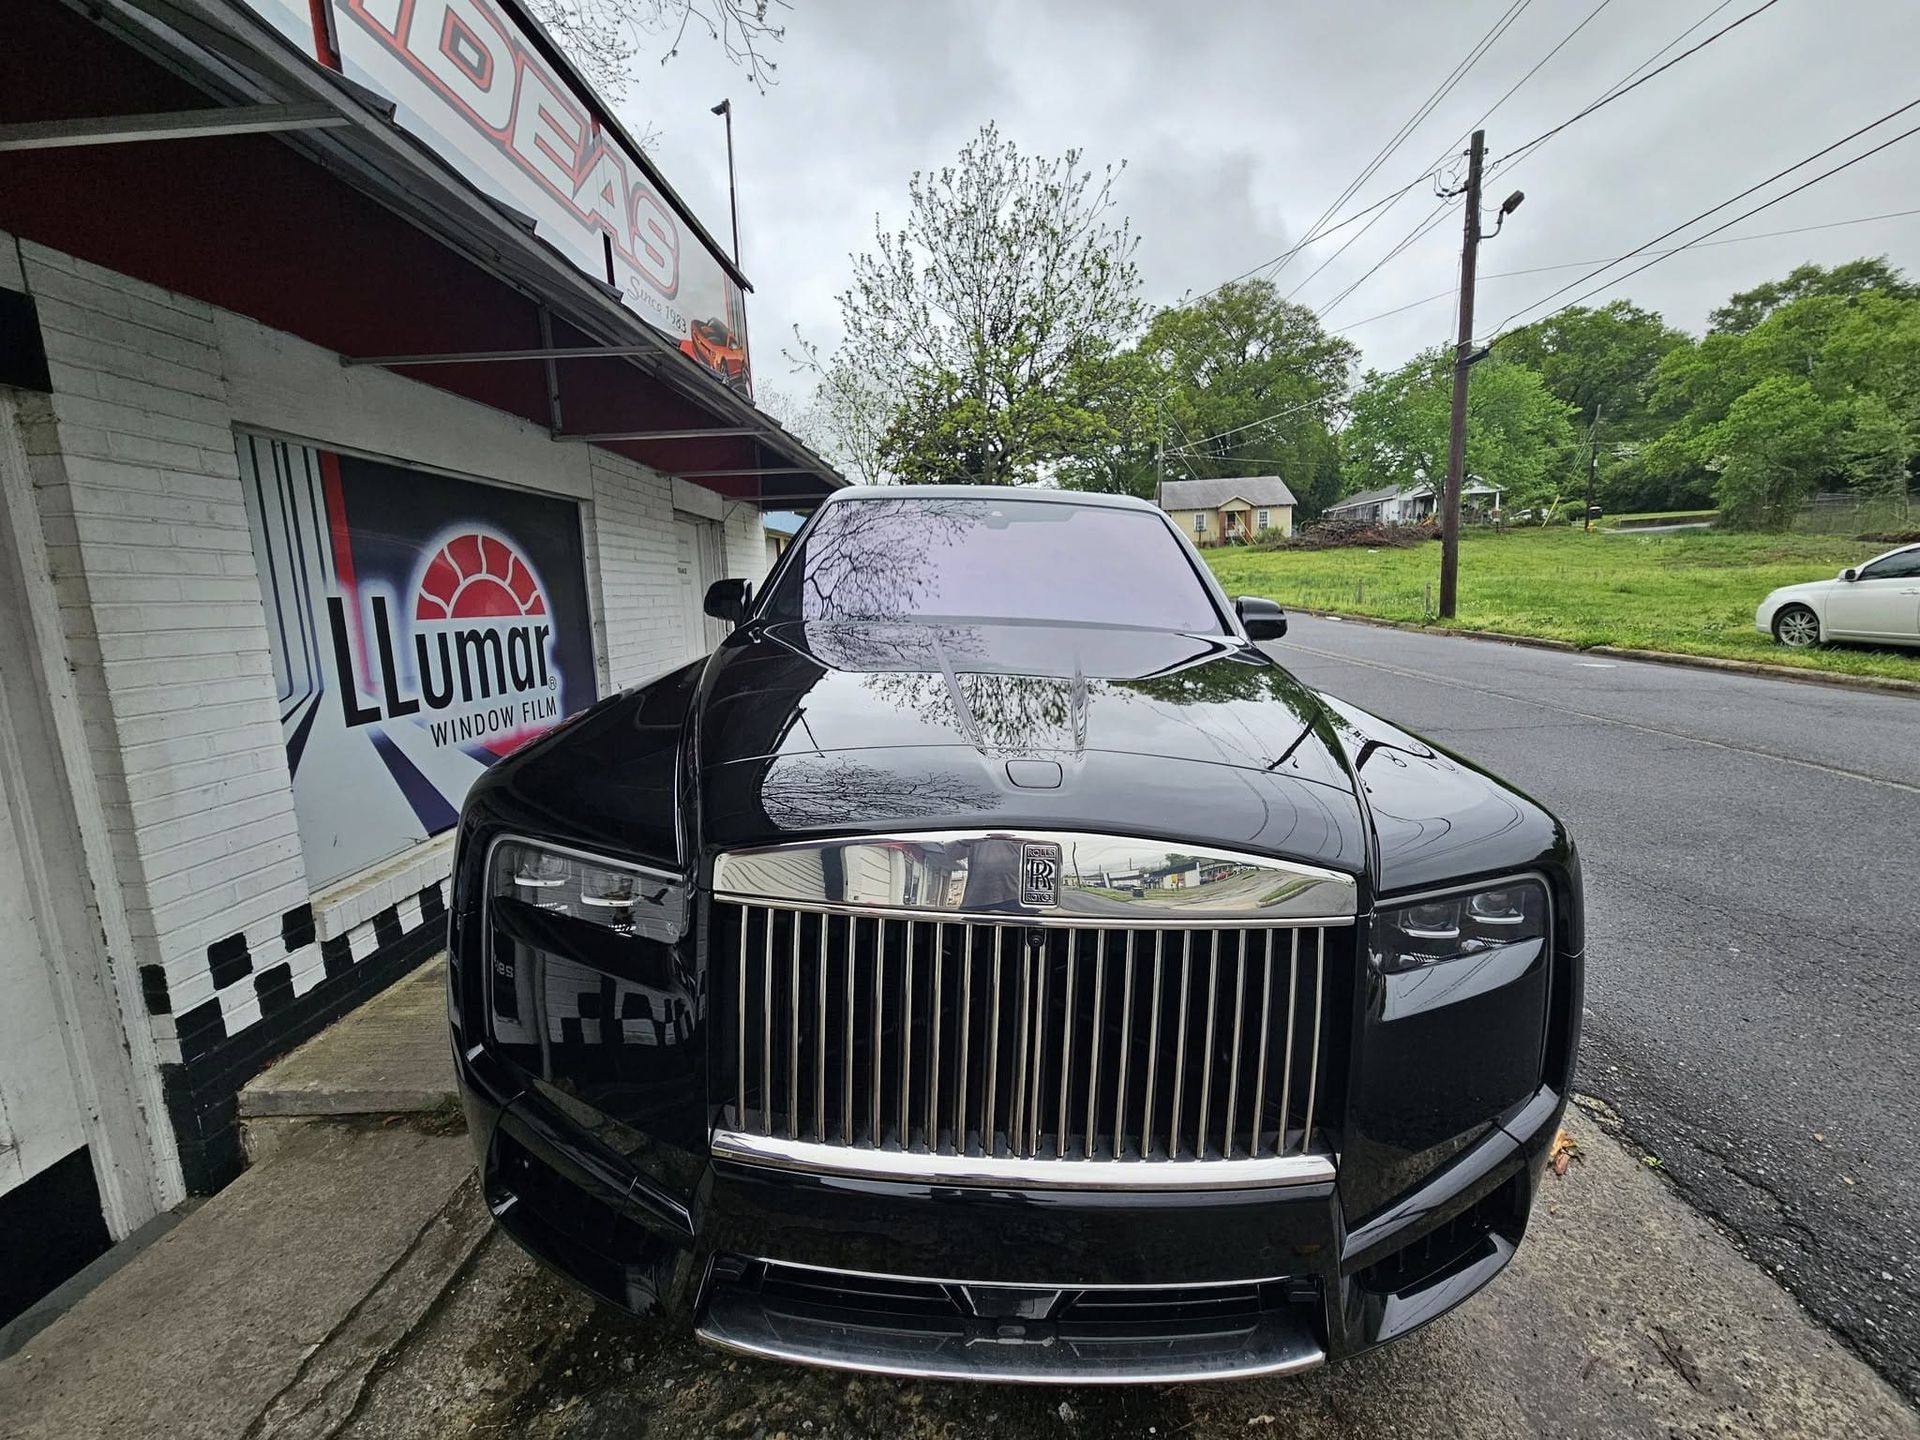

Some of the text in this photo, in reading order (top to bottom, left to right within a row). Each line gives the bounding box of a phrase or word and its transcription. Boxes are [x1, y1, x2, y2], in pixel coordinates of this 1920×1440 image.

[627, 276, 687, 333] Since 1983
[430, 696, 557, 748] WINDOW FILM
[1027, 847, 1055, 857] ROLLS
[1026, 893, 1054, 902] ROYCE
